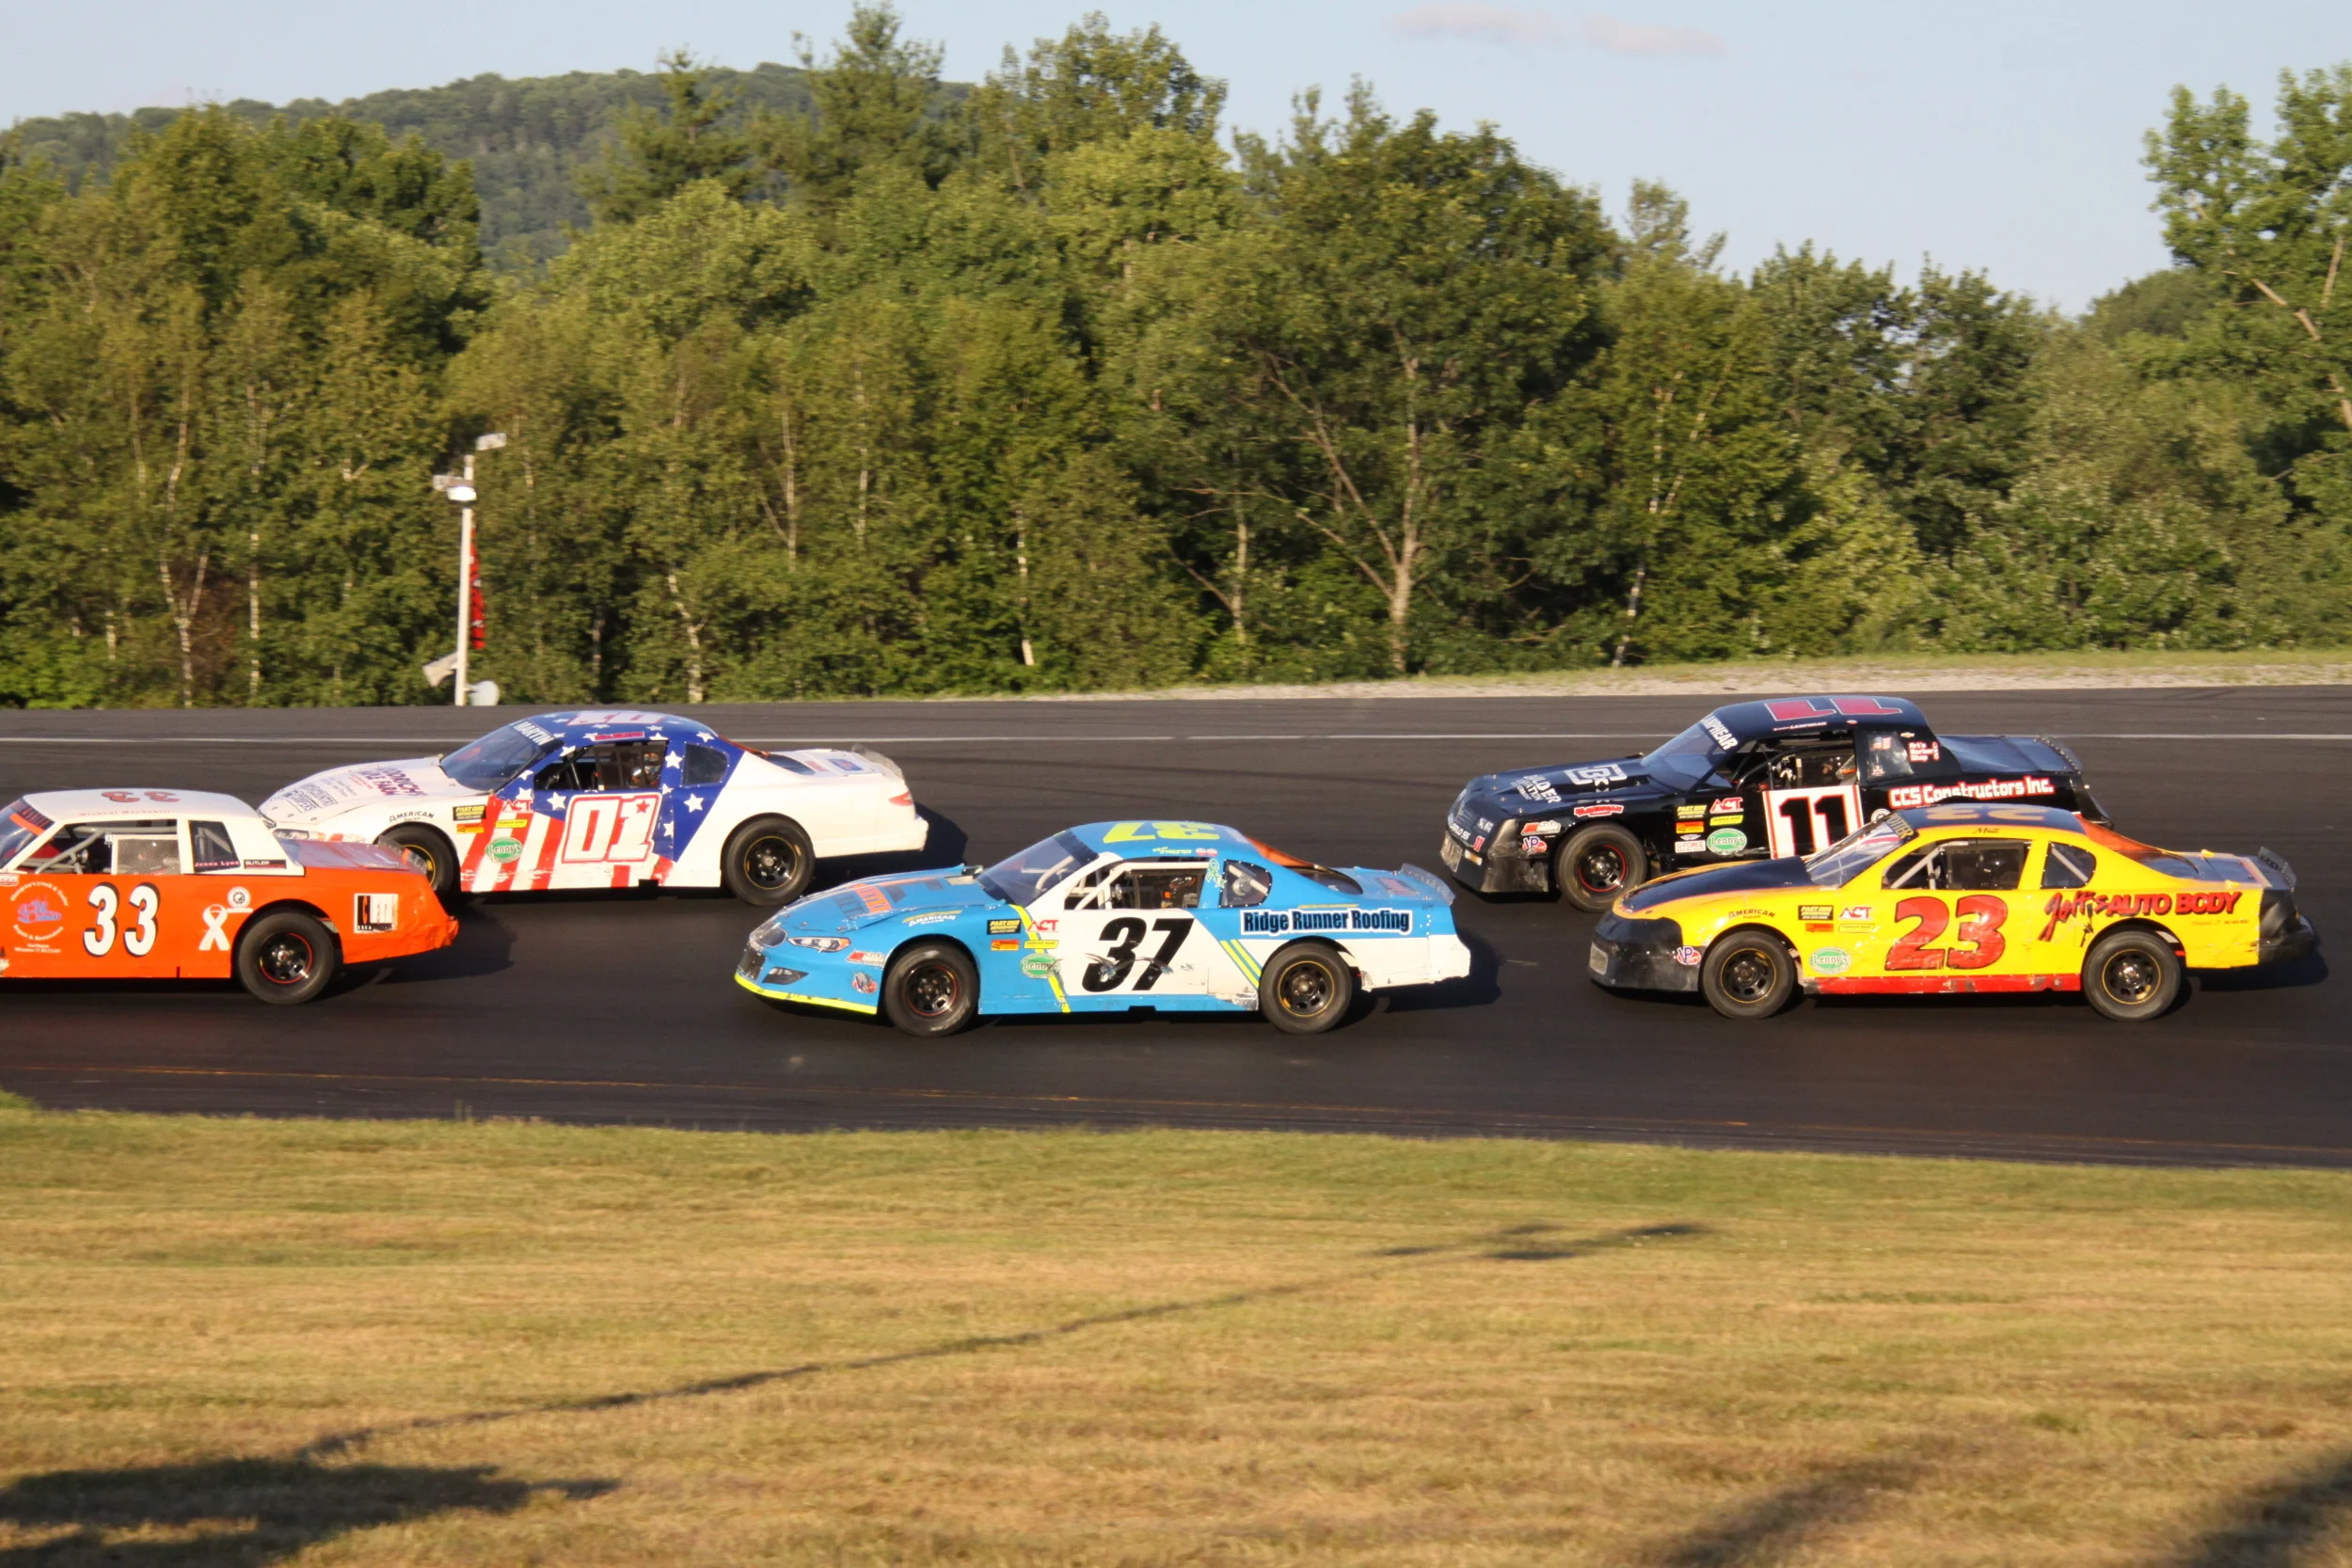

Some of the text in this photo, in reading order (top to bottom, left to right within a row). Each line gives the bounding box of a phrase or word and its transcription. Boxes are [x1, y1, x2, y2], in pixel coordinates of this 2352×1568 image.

[1890, 776, 2055, 807] CCS Constructors Inc.
[501, 799, 534, 812] ACT
[1709, 797, 1744, 814] ACT
[389, 810, 435, 823] AMERICAN
[562, 793, 663, 864] 01
[1778, 793, 1851, 857] 11
[1711, 835, 1744, 846] Lenny's
[489, 844, 522, 856] Lenny's
[2106, 894, 2172, 916] AUTO
[2175, 892, 2243, 915] BODY
[84, 882, 161, 958] 33
[908, 914, 957, 927] AMERICAN
[1728, 909, 1776, 919] AMERICAN
[1839, 907, 1873, 919] ACT
[1026, 919, 1058, 932] ACT
[1244, 909, 1410, 933] Ridge Runner Roofing
[1884, 895, 2009, 971] 23
[1082, 916, 1195, 993] 37
[1812, 954, 1849, 965] Lenny's
